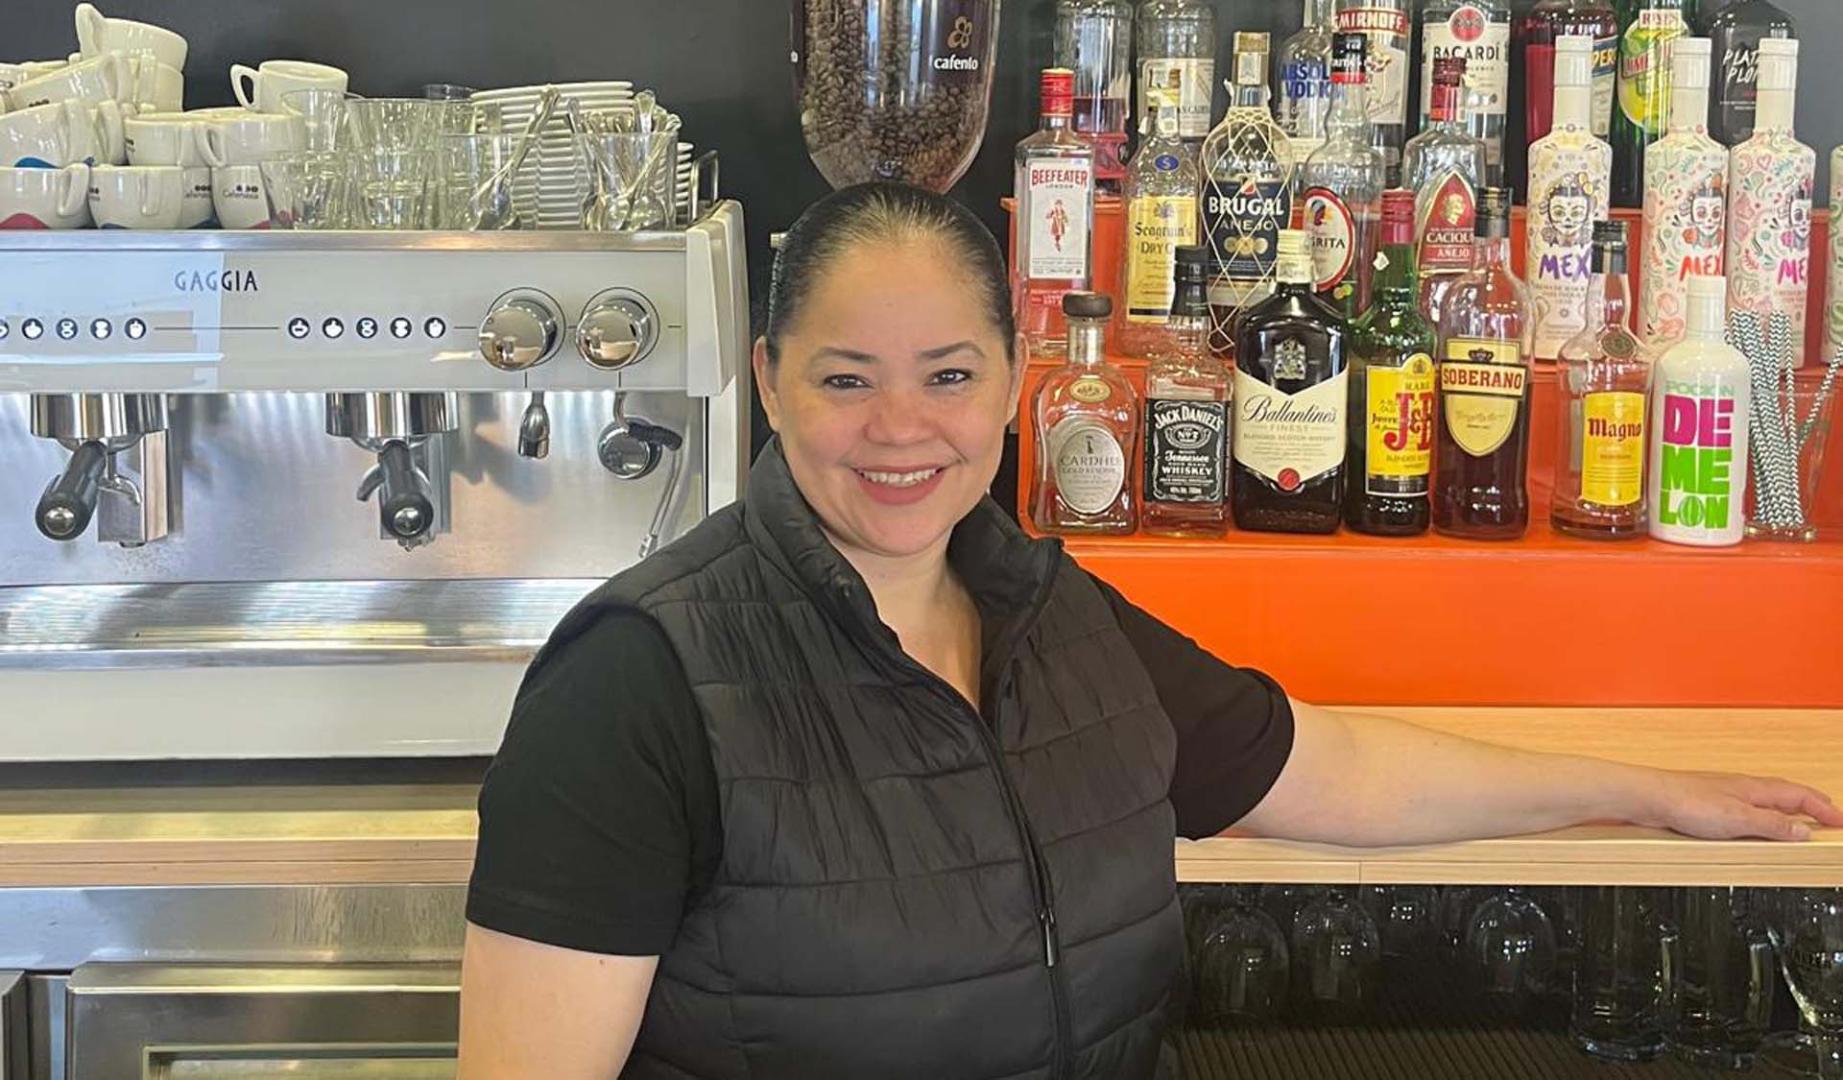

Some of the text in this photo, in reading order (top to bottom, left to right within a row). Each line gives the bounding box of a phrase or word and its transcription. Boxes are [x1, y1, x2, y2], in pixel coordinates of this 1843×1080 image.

[1031, 168, 1089, 188] BEEFEATER
[1208, 196, 1285, 216] BRUGAL
[1426, 231, 1475, 244] CACIQU
[174, 270, 258, 292] GAGGIA
[1443, 368, 1522, 390] SOBERANO
[1154, 409, 1182, 430] JACK
[1242, 394, 1337, 424] Ballantine's
[1587, 417, 1641, 442] Magno
[1662, 395, 1735, 448] DE
[1161, 465, 1213, 475] WHISKEY
[1660, 444, 1733, 495] ME
[1659, 489, 1729, 529] LON
